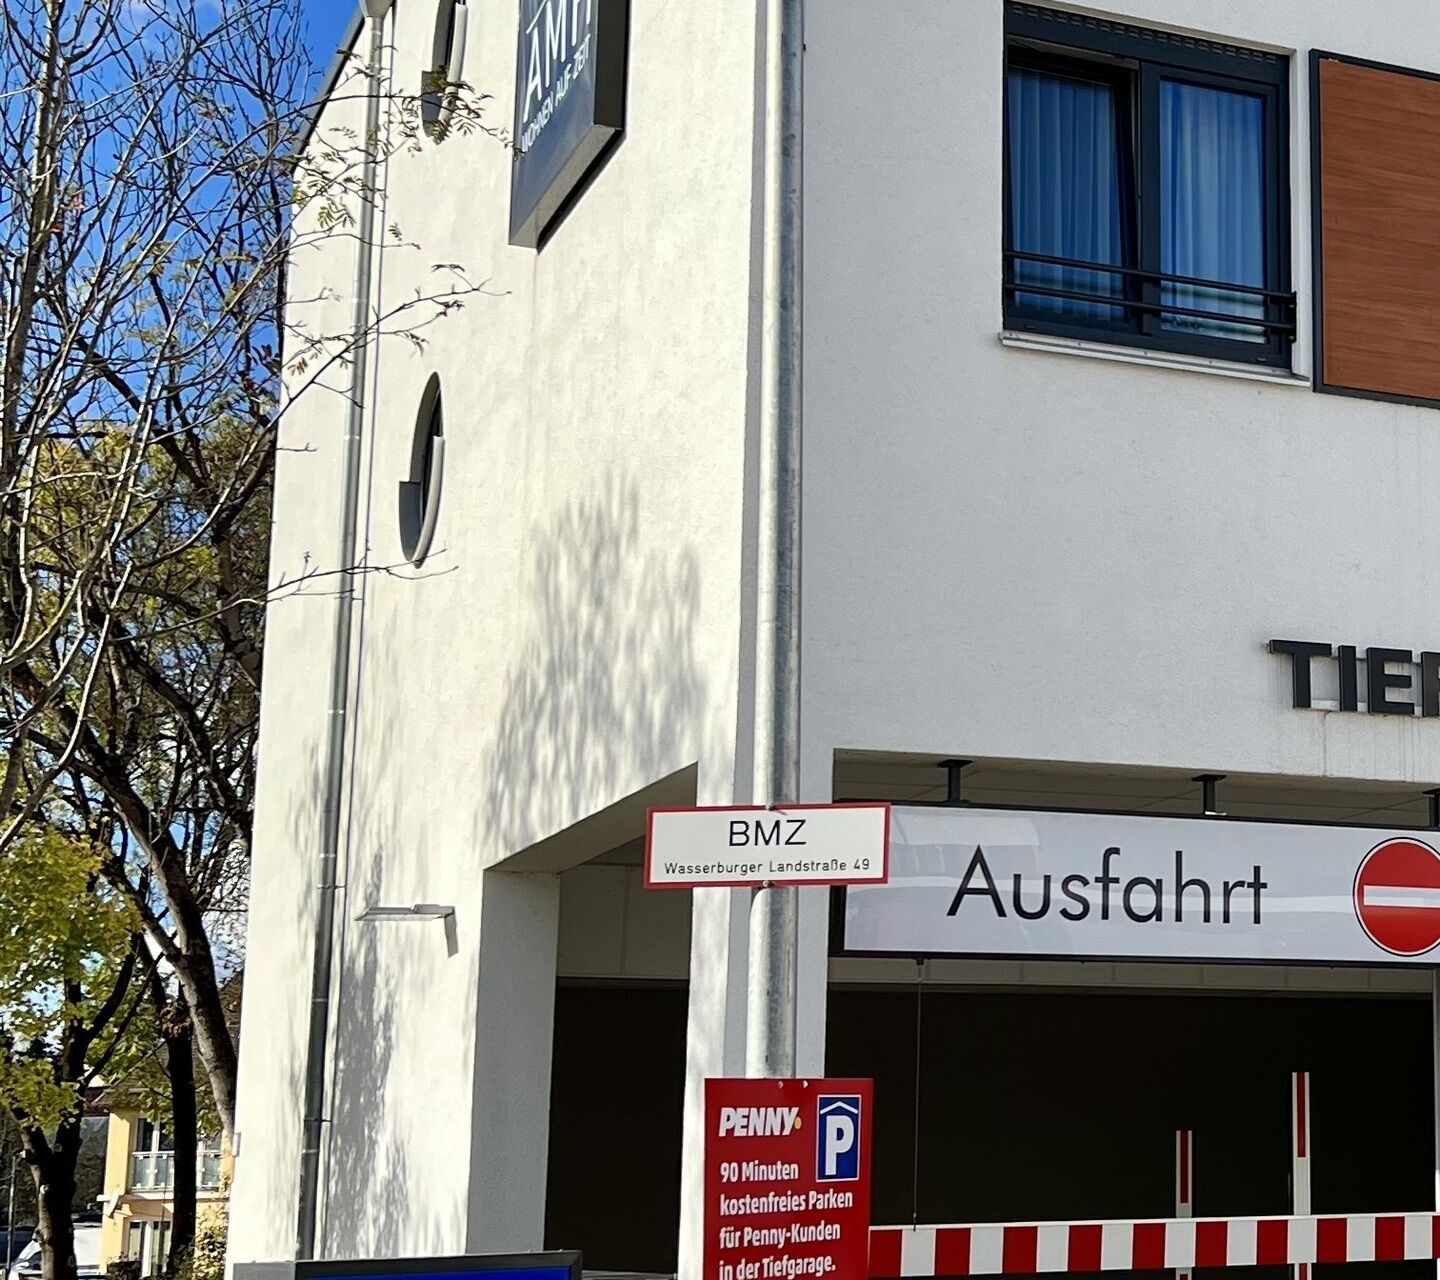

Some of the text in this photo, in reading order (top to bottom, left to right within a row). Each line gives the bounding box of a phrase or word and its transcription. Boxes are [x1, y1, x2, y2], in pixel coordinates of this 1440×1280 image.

[521, 33, 592, 152] WOHNEN AUF ZEIT
[728, 818, 807, 847] BMZ
[664, 858, 870, 876] Wasserburger Landstraße 49
[946, 844, 1268, 925] Ausfahrt
[825, 1115, 855, 1176] P
[720, 1160, 798, 1183] 90 Minuten
[720, 1188, 853, 1216] kostenfreies Parken
[719, 1221, 841, 1249] für Penny-Kunden
[736, 1258, 760, 1280] der
[762, 1254, 836, 1280] Tiefgarage.
